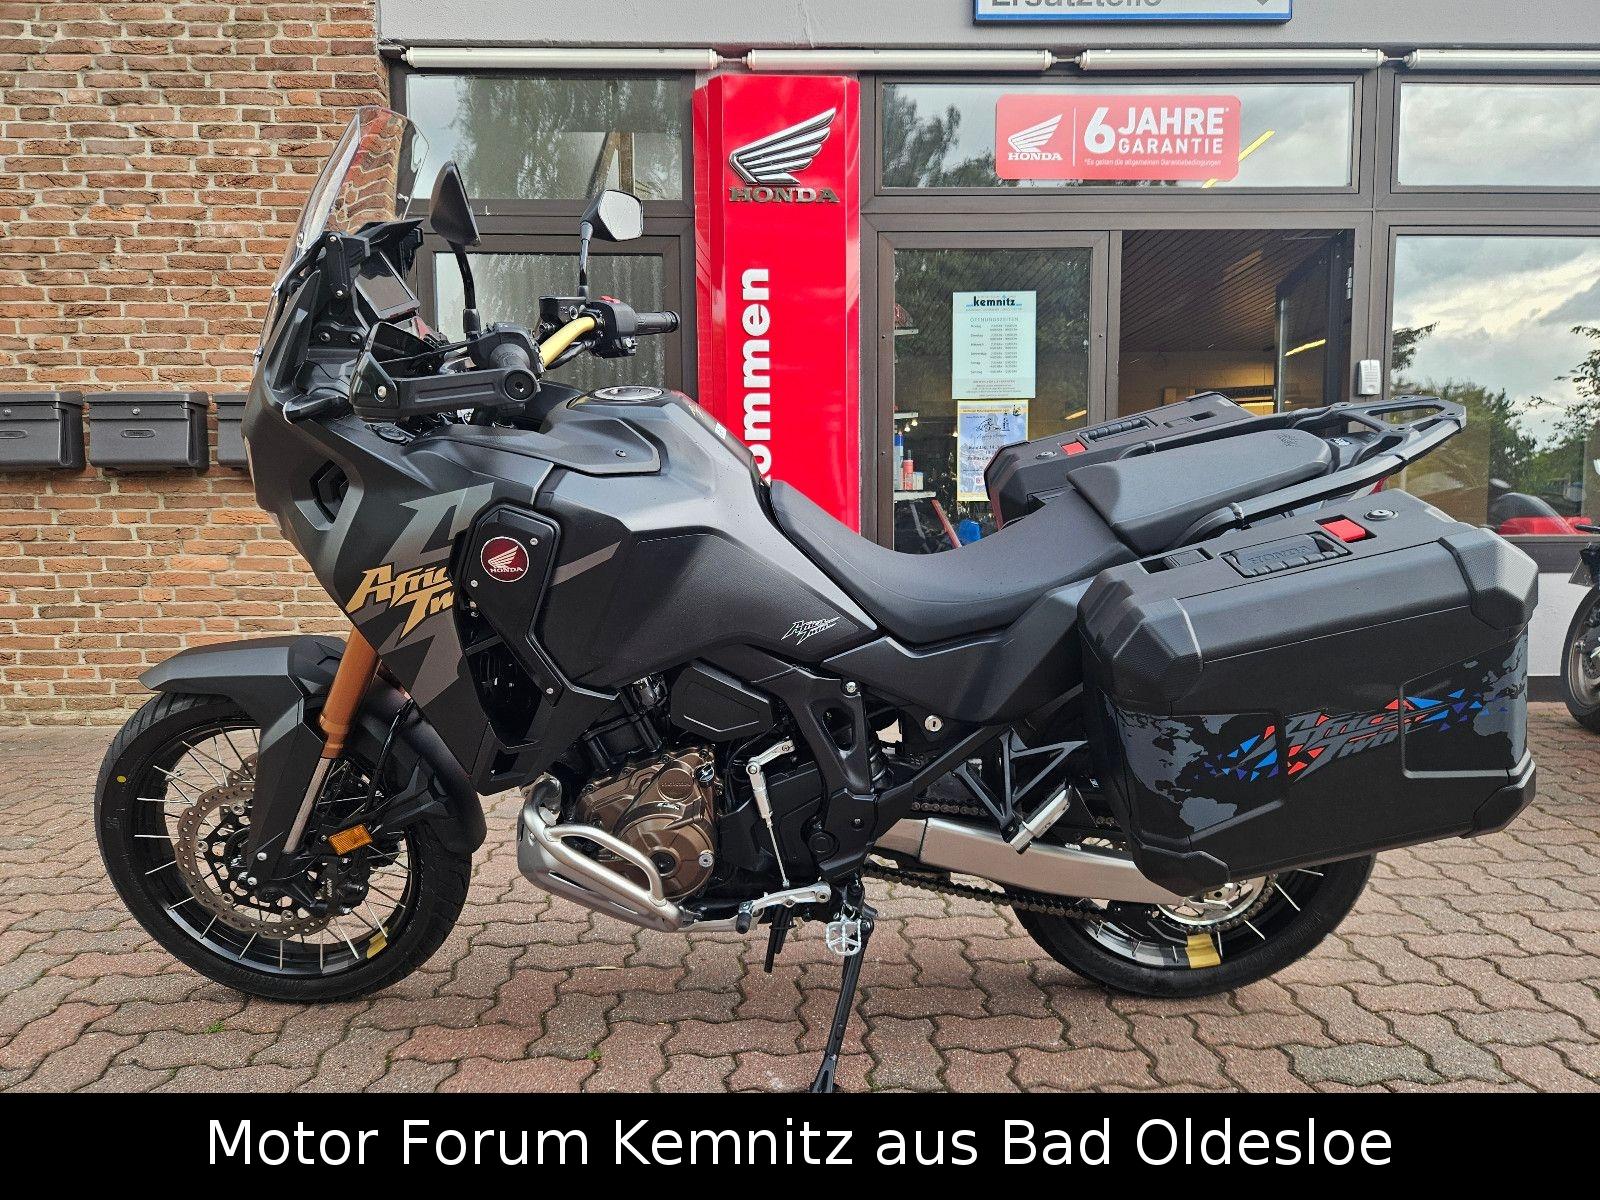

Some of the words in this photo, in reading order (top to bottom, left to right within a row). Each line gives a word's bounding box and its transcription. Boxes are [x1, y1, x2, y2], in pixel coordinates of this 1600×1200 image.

[1084, 107, 1116, 154] 6
[1118, 138, 1223, 154] GARANTIE
[1007, 152, 1063, 161] HONDA
[729, 187, 840, 203] HONDA
[973, 295, 1016, 307] kemnitz
[741, 268, 772, 485] ommen
[345, 564, 450, 615] Afric
